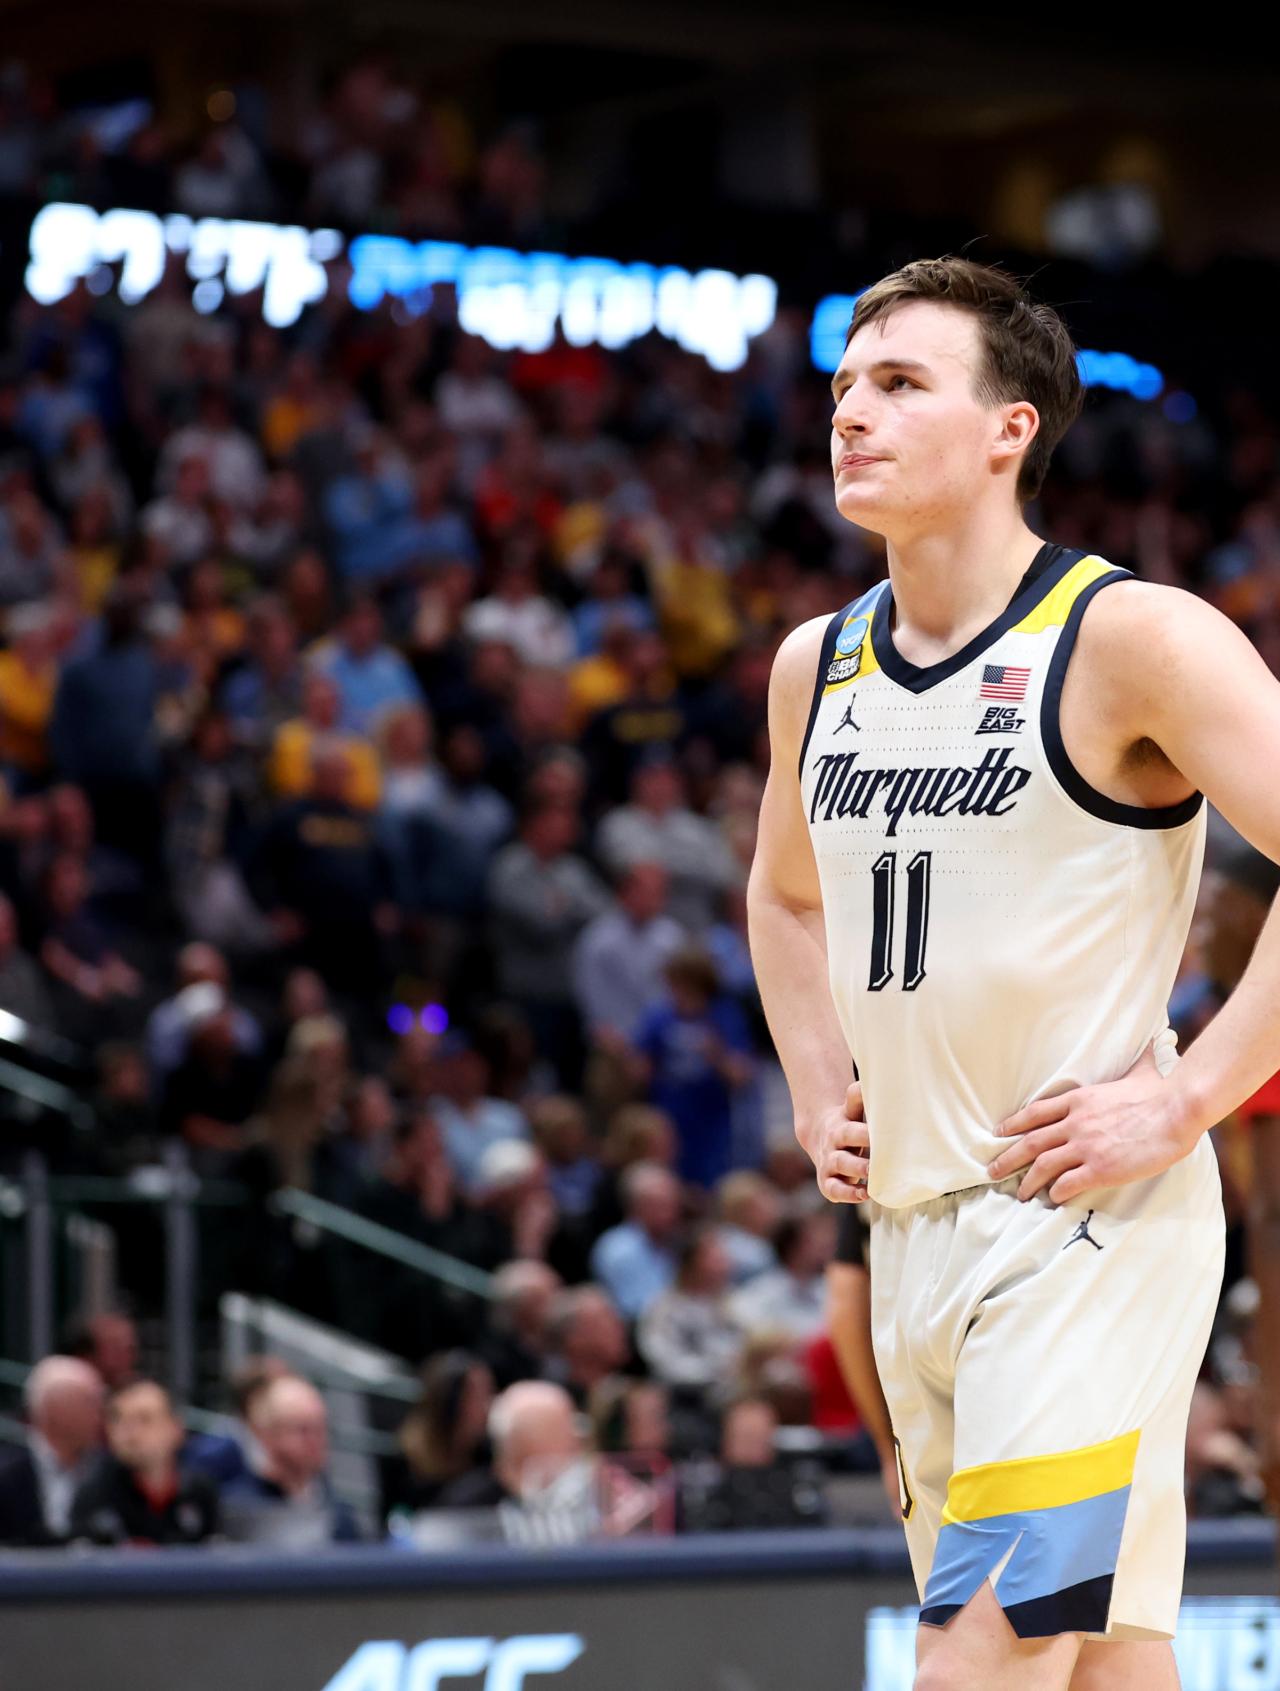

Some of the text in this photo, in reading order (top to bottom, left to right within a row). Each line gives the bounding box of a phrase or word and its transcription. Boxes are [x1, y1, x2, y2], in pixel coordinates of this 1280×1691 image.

[978, 718, 1026, 730] EAST
[984, 706, 1018, 719] BIG
[810, 747, 1032, 837] Marquette
[867, 850, 932, 992] 11
